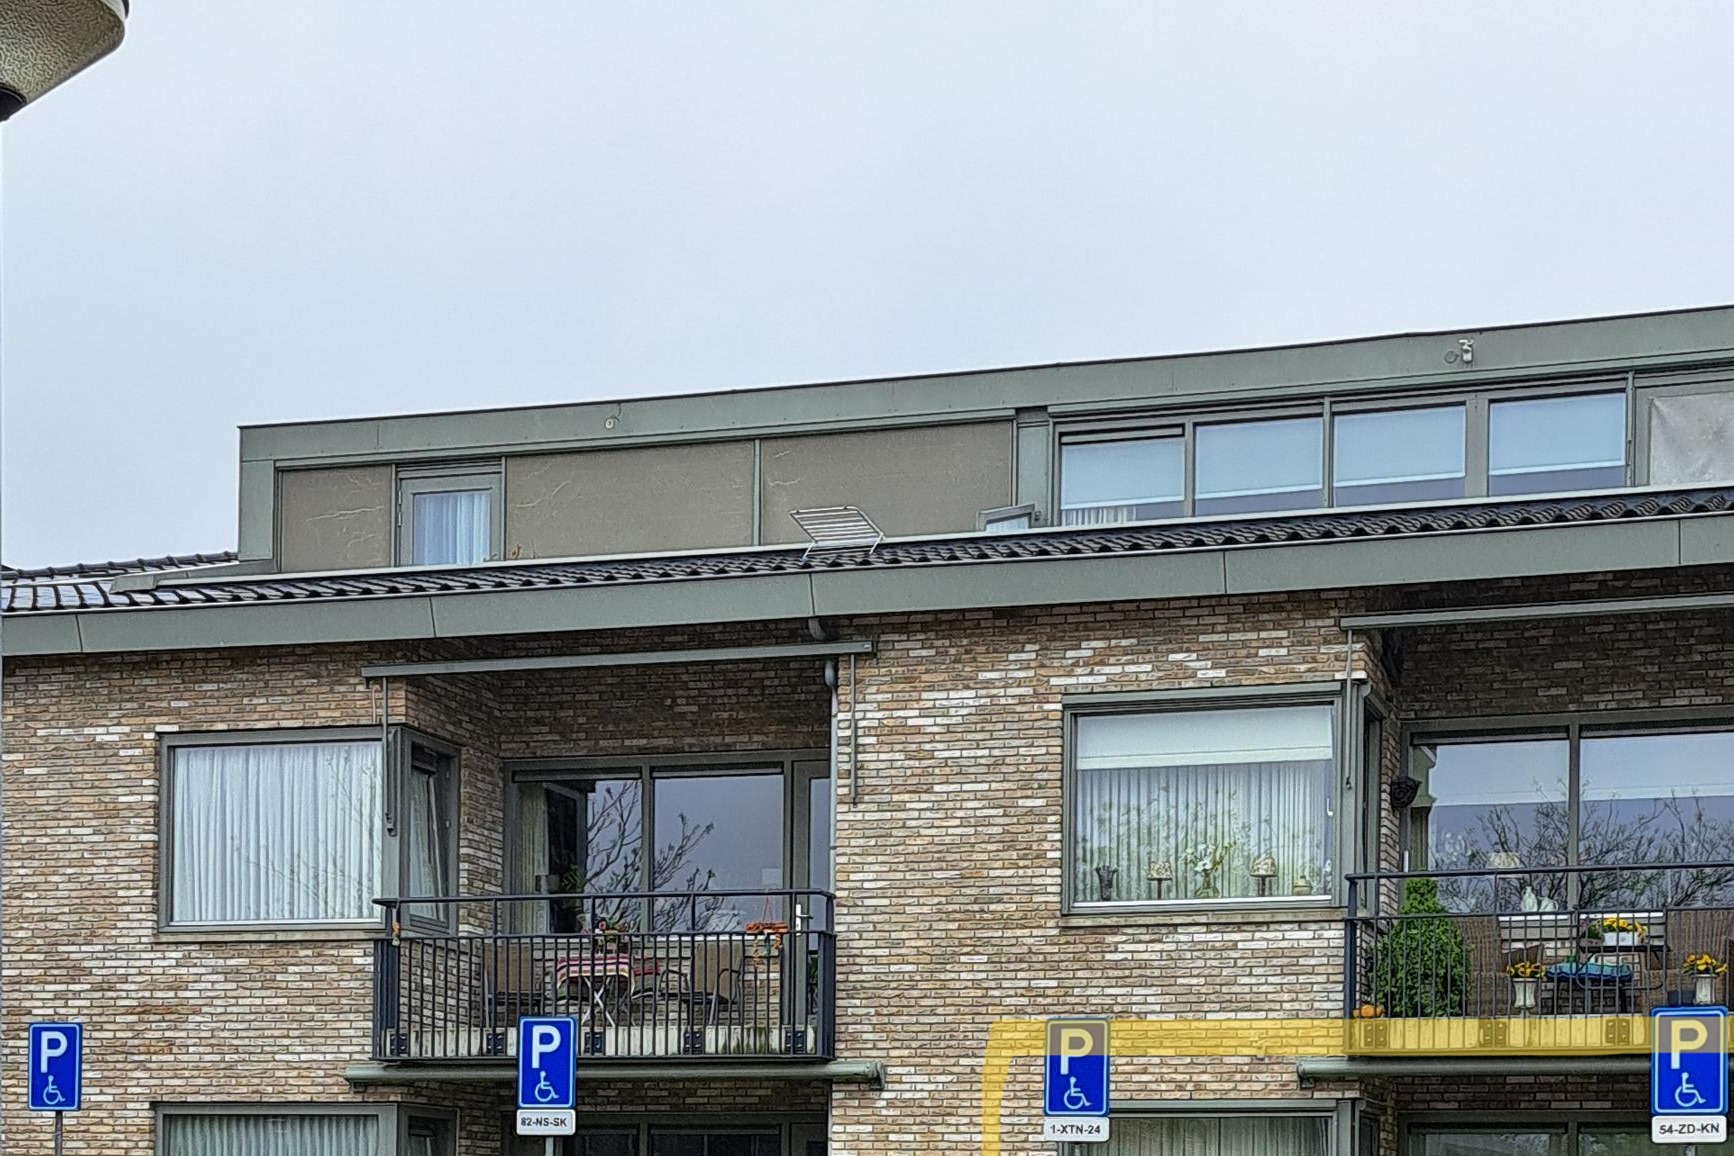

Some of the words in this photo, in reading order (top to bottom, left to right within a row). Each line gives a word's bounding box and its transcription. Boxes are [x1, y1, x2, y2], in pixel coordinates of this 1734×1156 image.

[40, 1030, 68, 1073] P
[531, 1024, 561, 1069] P
[1060, 1028, 1093, 1075] P
[1671, 1019, 1708, 1070] P
[520, 1116, 567, 1127] 82-NS-SK
[1050, 1124, 1101, 1135] 1-XTN-24
[1658, 1122, 1720, 1135] 54-ZD-KN
